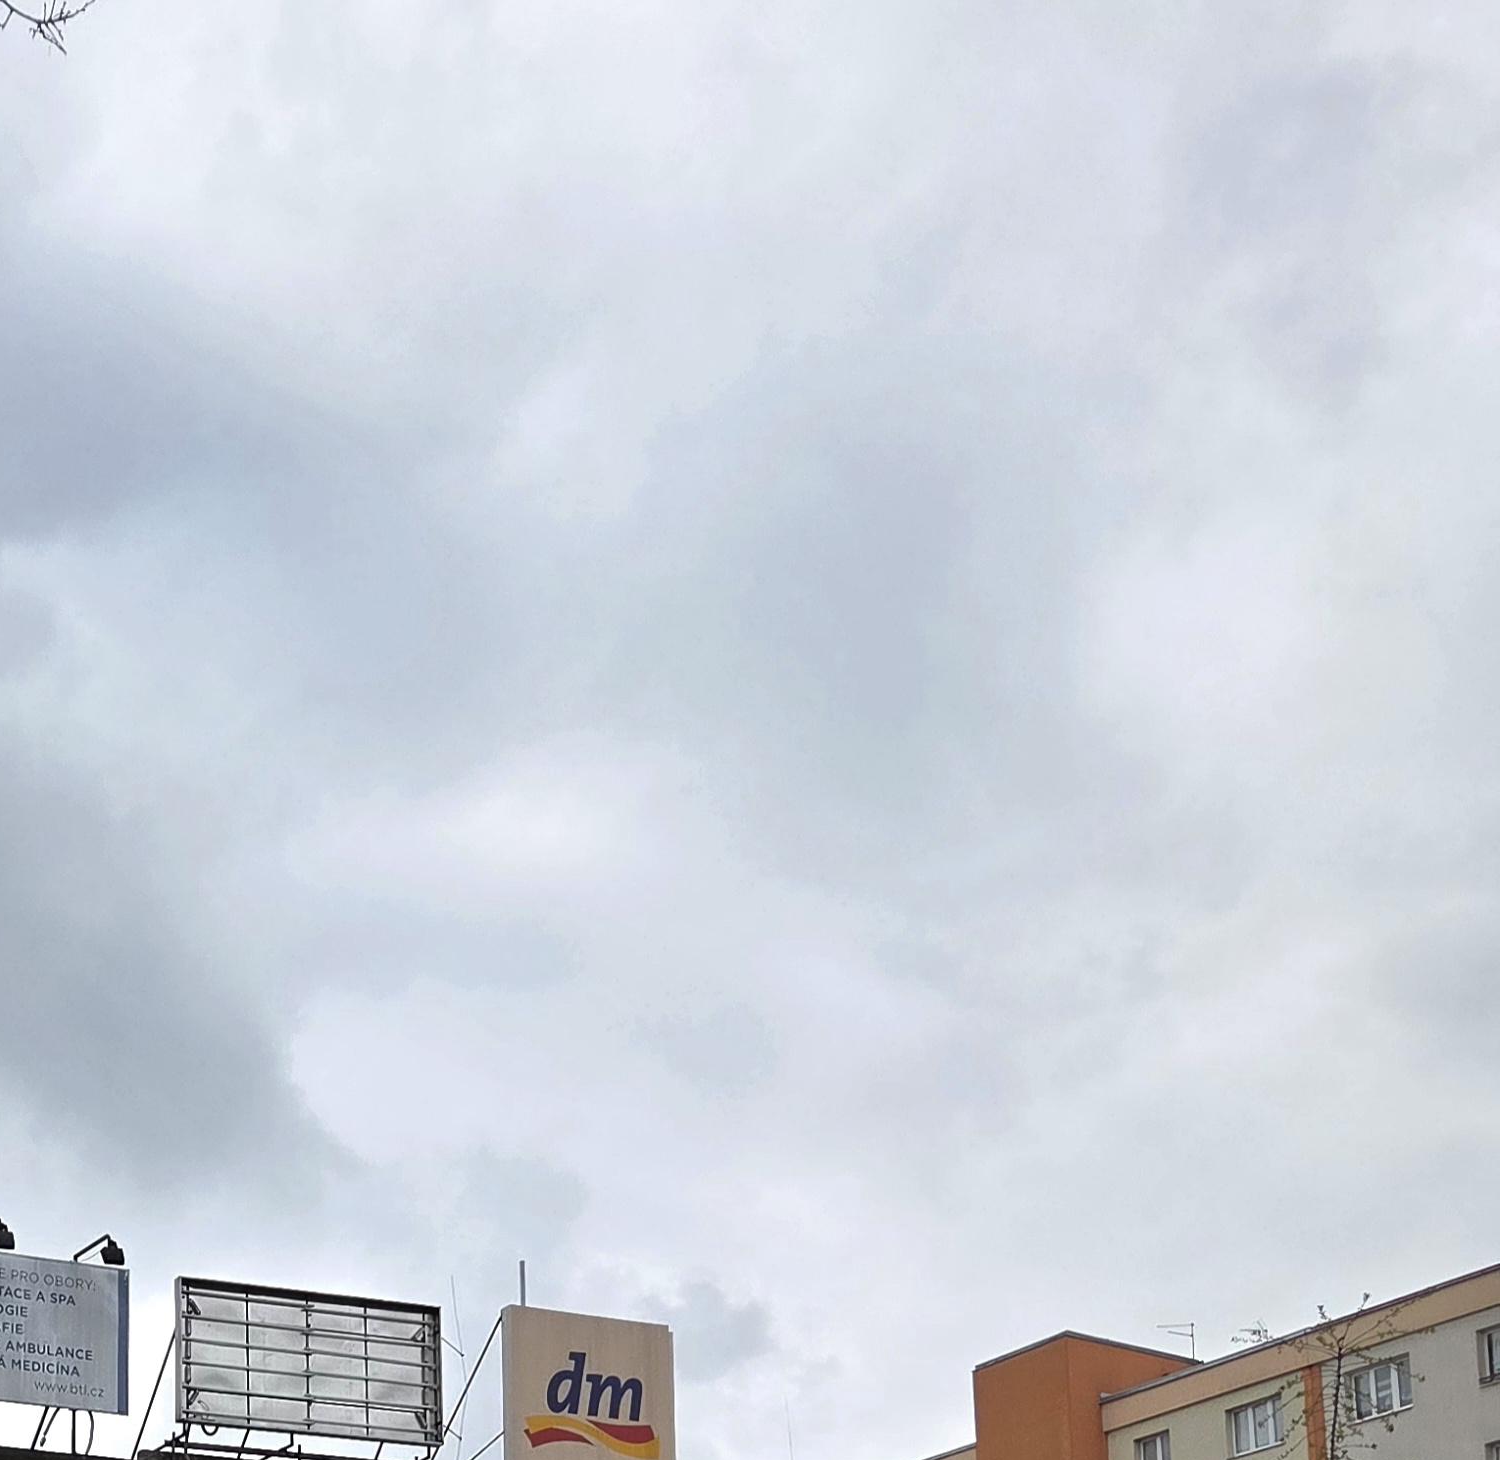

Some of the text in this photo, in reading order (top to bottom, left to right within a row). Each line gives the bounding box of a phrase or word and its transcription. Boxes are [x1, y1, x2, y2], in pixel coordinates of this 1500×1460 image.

[11, 1269, 39, 1283] PRO
[44, 1274, 96, 1292] OBORY:
[36, 1291, 45, 1302] A
[50, 1293, 76, 1306] SPA
[6, 1341, 93, 1361] AMBULANCE
[11, 1359, 80, 1377] MEDICÍNA
[34, 1380, 105, 1398] www.btl.cz
[546, 1351, 643, 1422] dm
